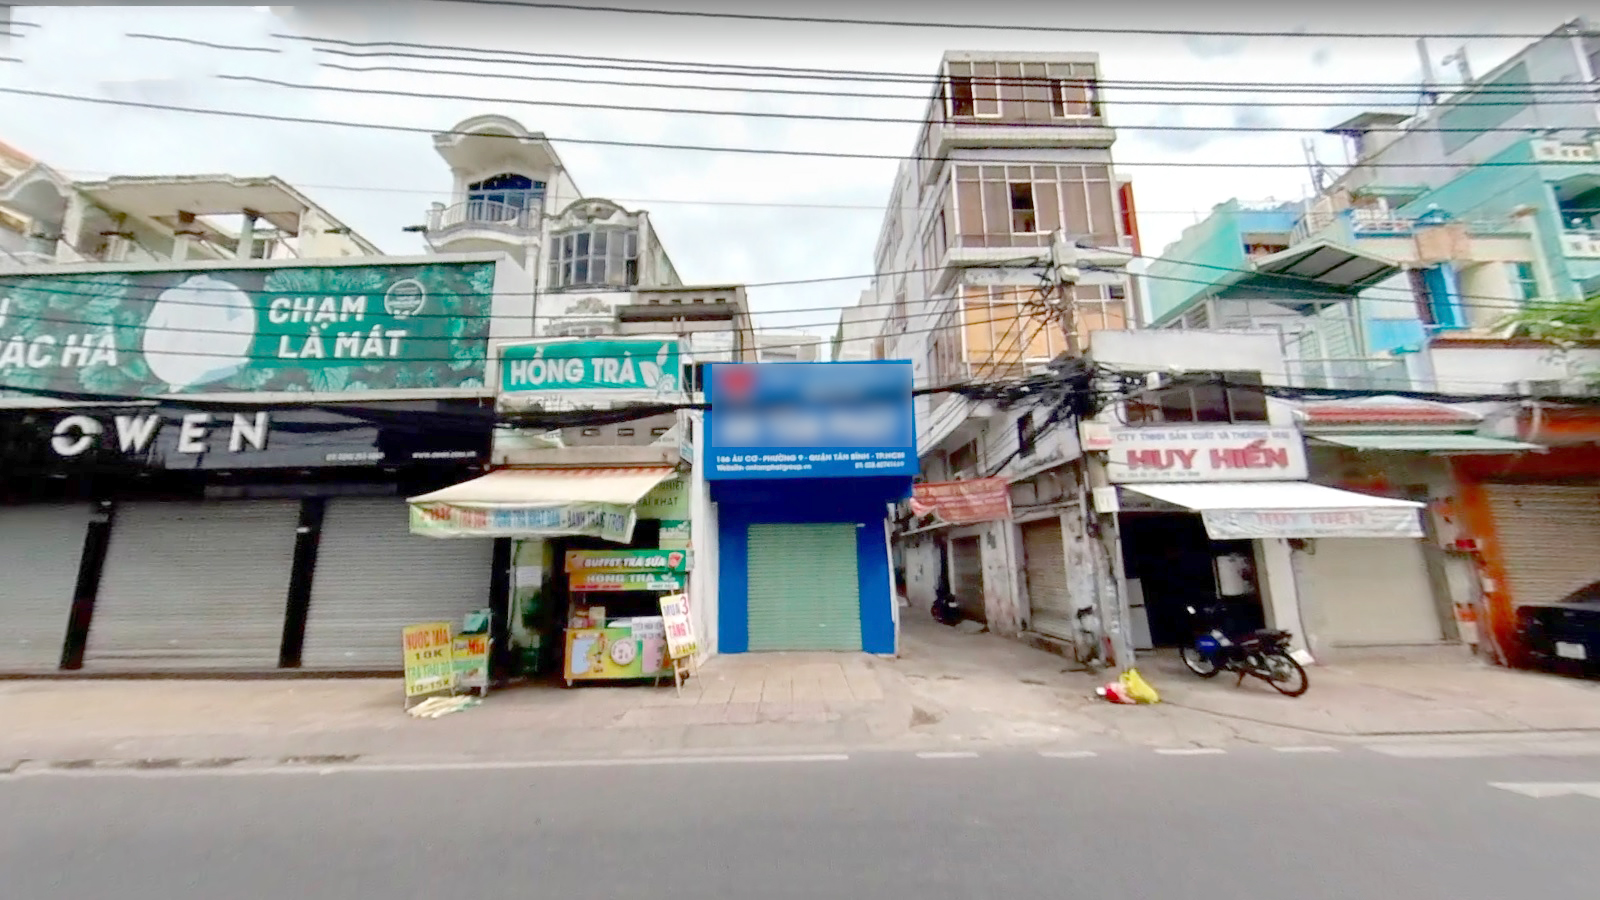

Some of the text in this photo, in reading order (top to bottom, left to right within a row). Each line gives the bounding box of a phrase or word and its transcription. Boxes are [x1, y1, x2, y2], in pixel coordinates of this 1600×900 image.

[267, 296, 367, 329] CHẠM
[278, 324, 408, 359] LÀ MÁT
[592, 351, 636, 383] TRÀ
[52, 412, 270, 457] OWEN
[1127, 449, 1198, 469] HUY
